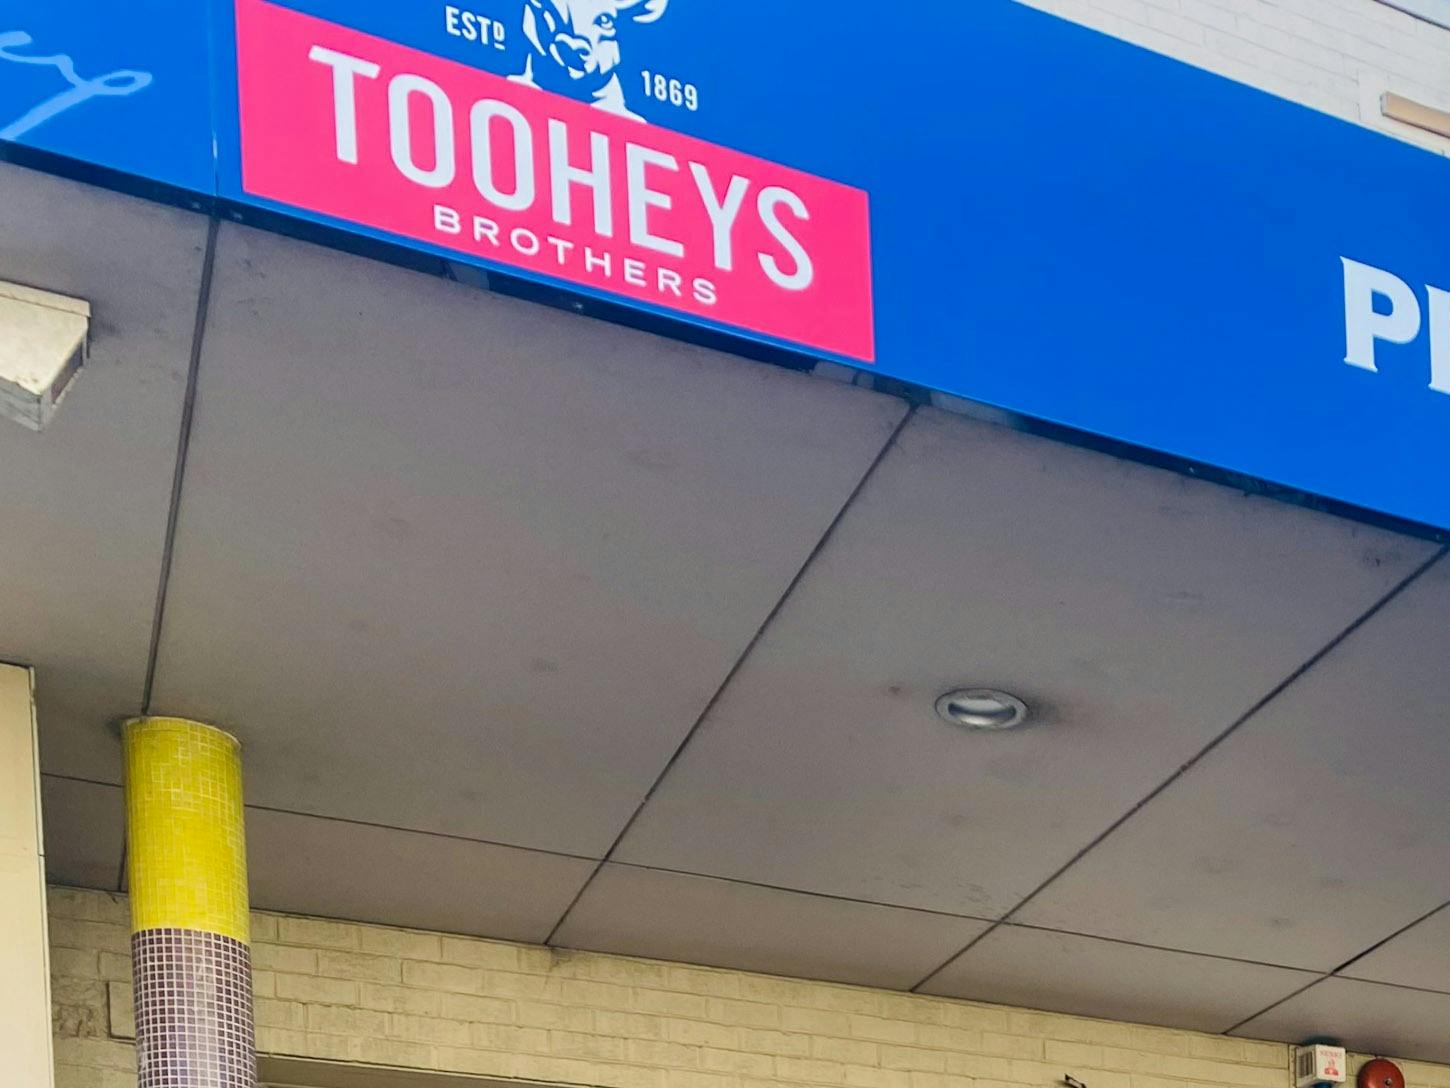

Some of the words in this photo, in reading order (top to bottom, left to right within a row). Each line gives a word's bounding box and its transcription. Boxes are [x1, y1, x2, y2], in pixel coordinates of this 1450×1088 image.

[641, 70, 698, 112] 1869
[308, 45, 814, 291] TOOHEYS
[433, 204, 718, 306] BROTHERS
